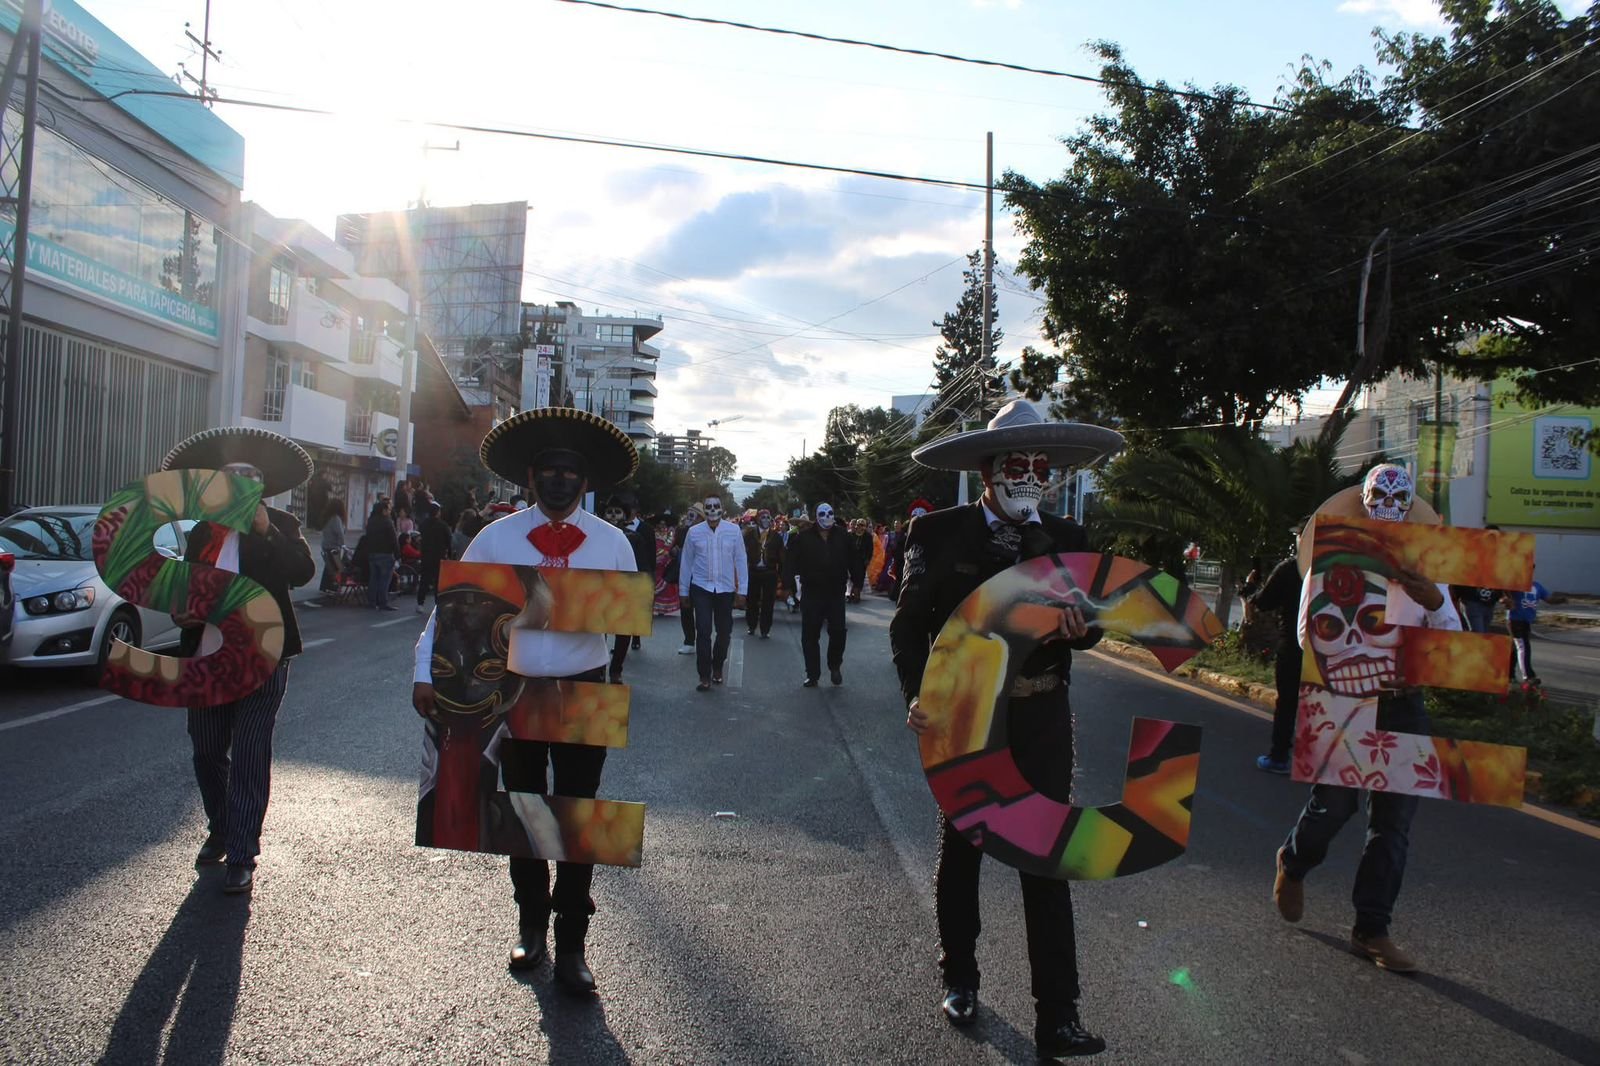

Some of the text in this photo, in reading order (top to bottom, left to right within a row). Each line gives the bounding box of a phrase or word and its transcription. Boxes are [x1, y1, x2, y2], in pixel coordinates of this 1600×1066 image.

[26, 239, 36, 259] Y
[40, 243, 117, 293] MATERIALES
[118, 279, 147, 305] PARA
[149, 289, 197, 324] TAPICERÍA
[92, 469, 285, 708] S
[415, 560, 655, 867] E
[1291, 513, 1535, 808] E
